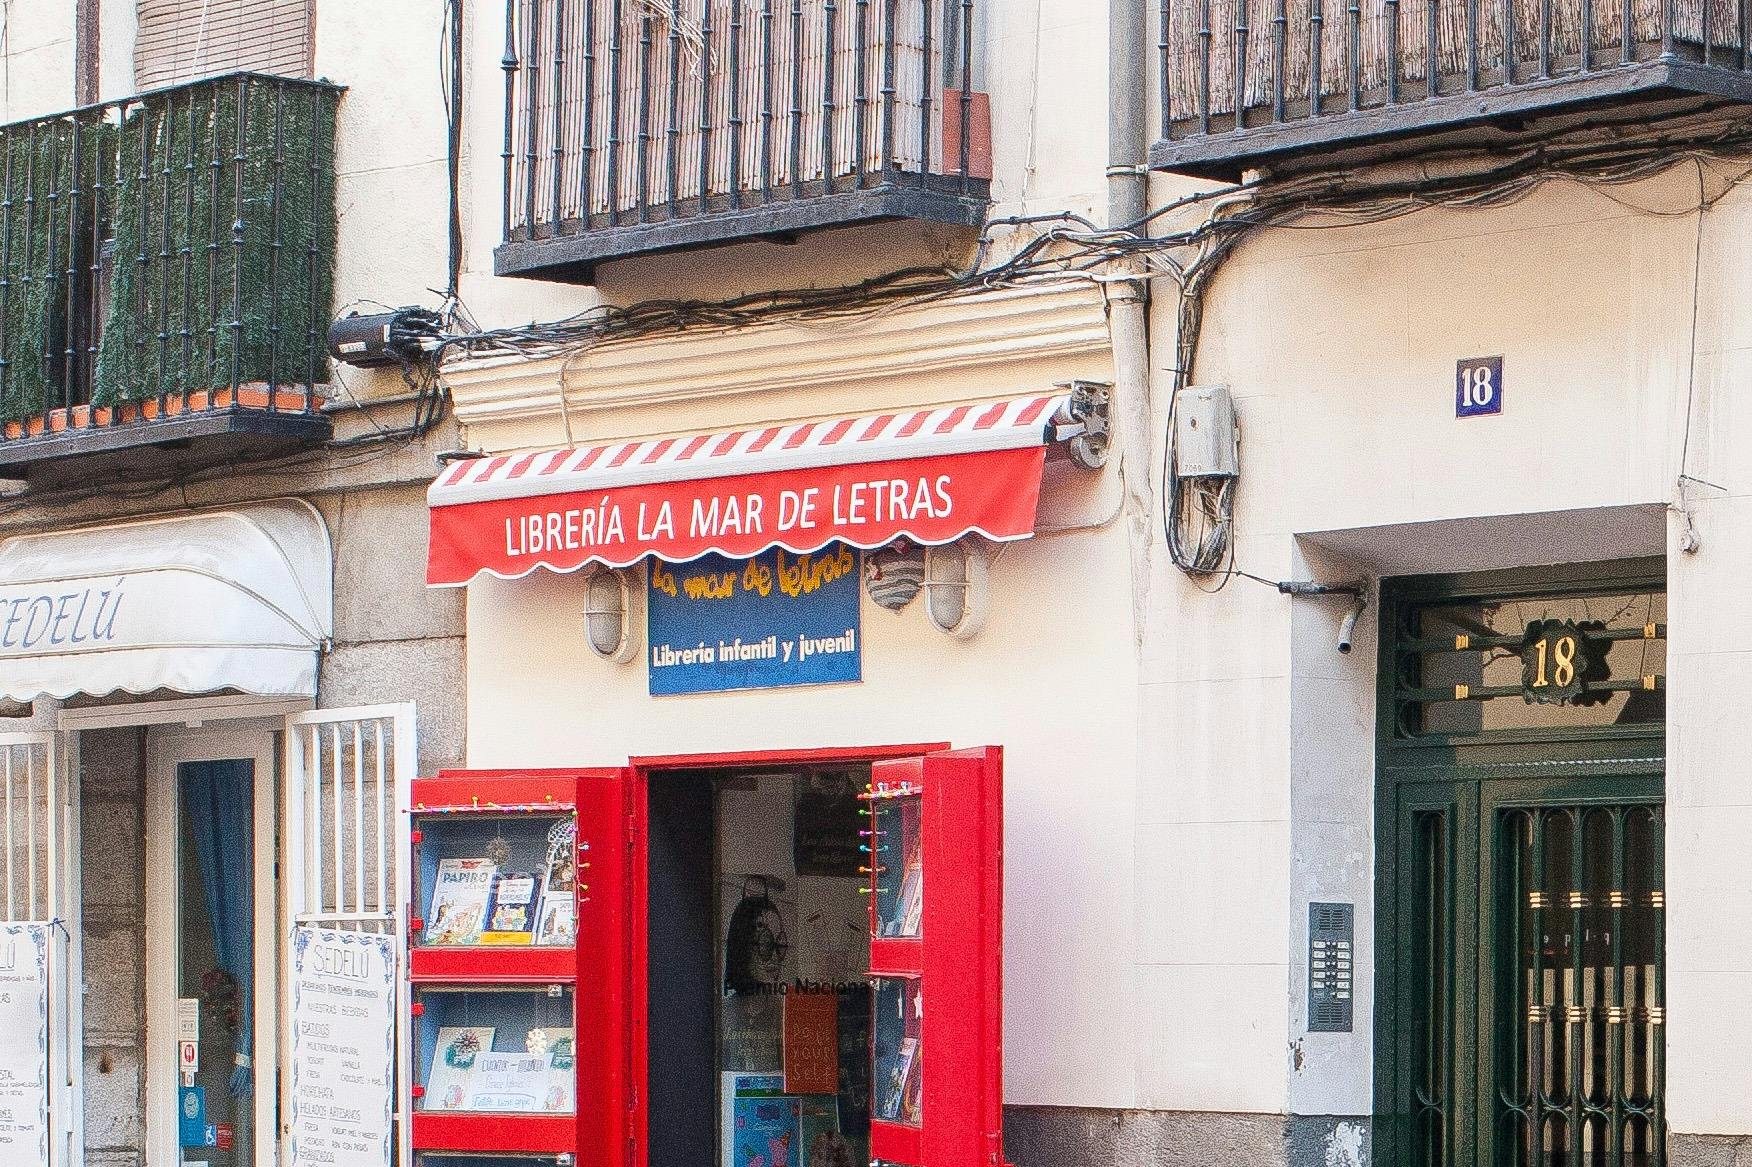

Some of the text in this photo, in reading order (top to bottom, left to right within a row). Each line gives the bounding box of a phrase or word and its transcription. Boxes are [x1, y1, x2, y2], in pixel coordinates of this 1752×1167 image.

[1461, 366, 1495, 408] 18
[506, 475, 953, 556] LIBRERÍA LA MAR DE LETRAS
[0, 577, 124, 648] EDELÚ
[653, 629, 855, 667] Librería infantil y juvenil
[1532, 636, 1576, 689] 18
[314, 945, 369, 978] SEDELÚ
[795, 977, 870, 996] Naciona
